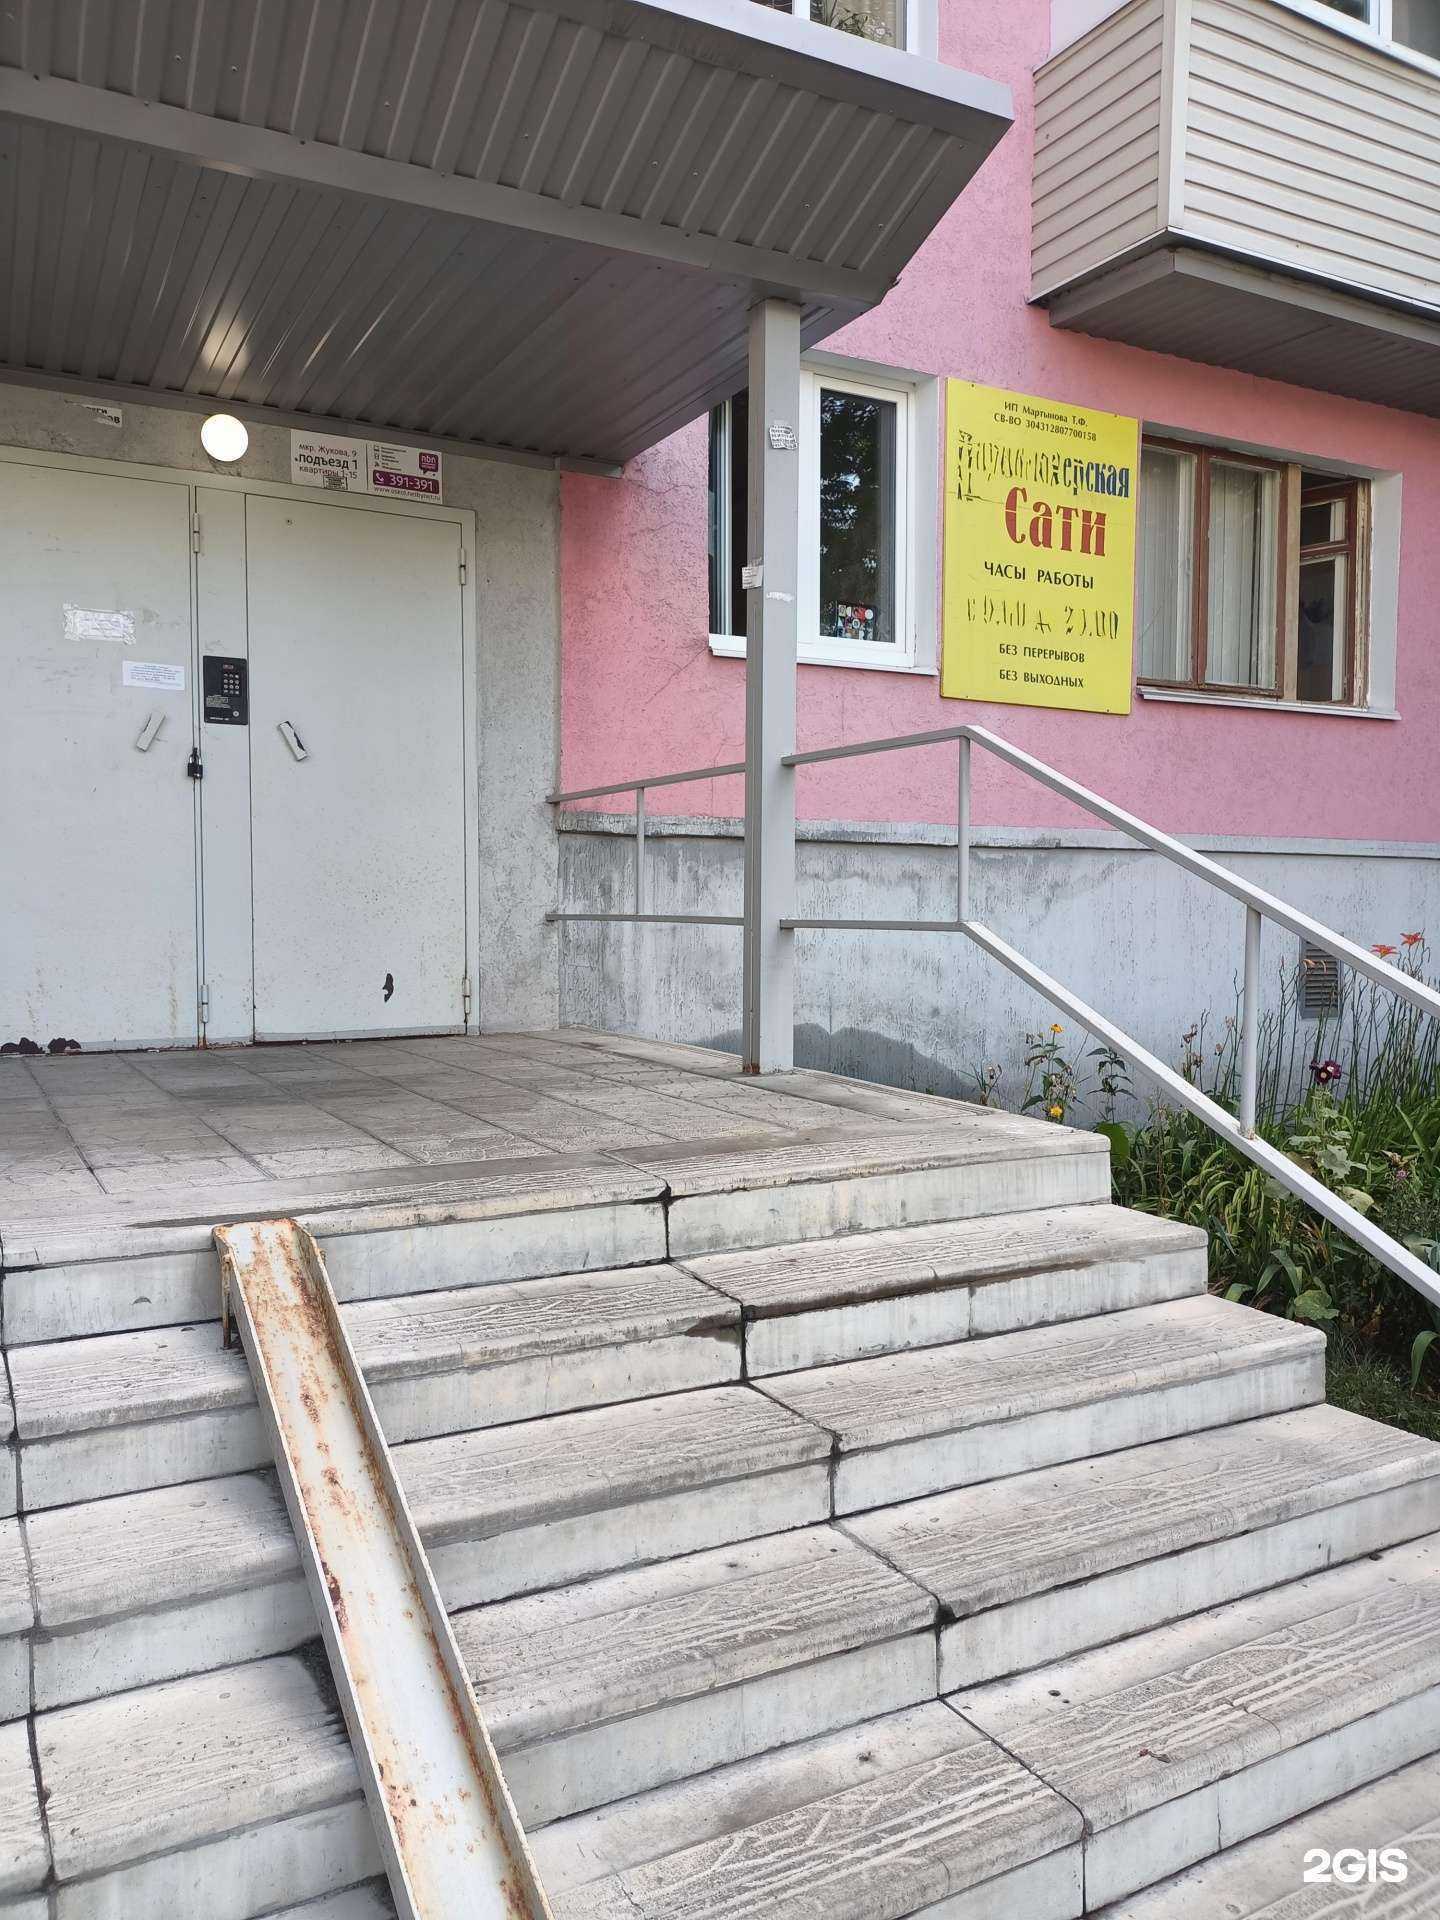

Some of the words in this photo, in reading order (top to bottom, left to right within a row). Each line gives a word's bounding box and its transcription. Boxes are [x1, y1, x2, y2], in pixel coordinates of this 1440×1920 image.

[1004, 401, 1018, 413] ИП
[1022, 407, 1068, 424] Мартынова
[1072, 415, 1088, 428] Т.Ф.
[994, 413, 1022, 426] СВ-ВО
[1025, 419, 1097, 442] 304312807700158
[299, 453, 350, 470] подъезд
[352, 460, 358, 470] 1
[421, 455, 436, 464] nbn
[300, 466, 339, 477] квартиры
[340, 470, 358, 480] 1-15
[389, 474, 433, 492] 391-391
[1005, 486, 1107, 557] Сати
[984, 561, 1026, 581] ЧАСЫ
[1037, 569, 1094, 589] РАБОТЫ
[999, 643, 1018, 656] БЕЗ
[1023, 646, 1086, 663] ПЕРЕРЫВОВ
[999, 669, 1018, 682] БЕЗ
[1023, 672, 1085, 689] ВЫХОДНЫХ
